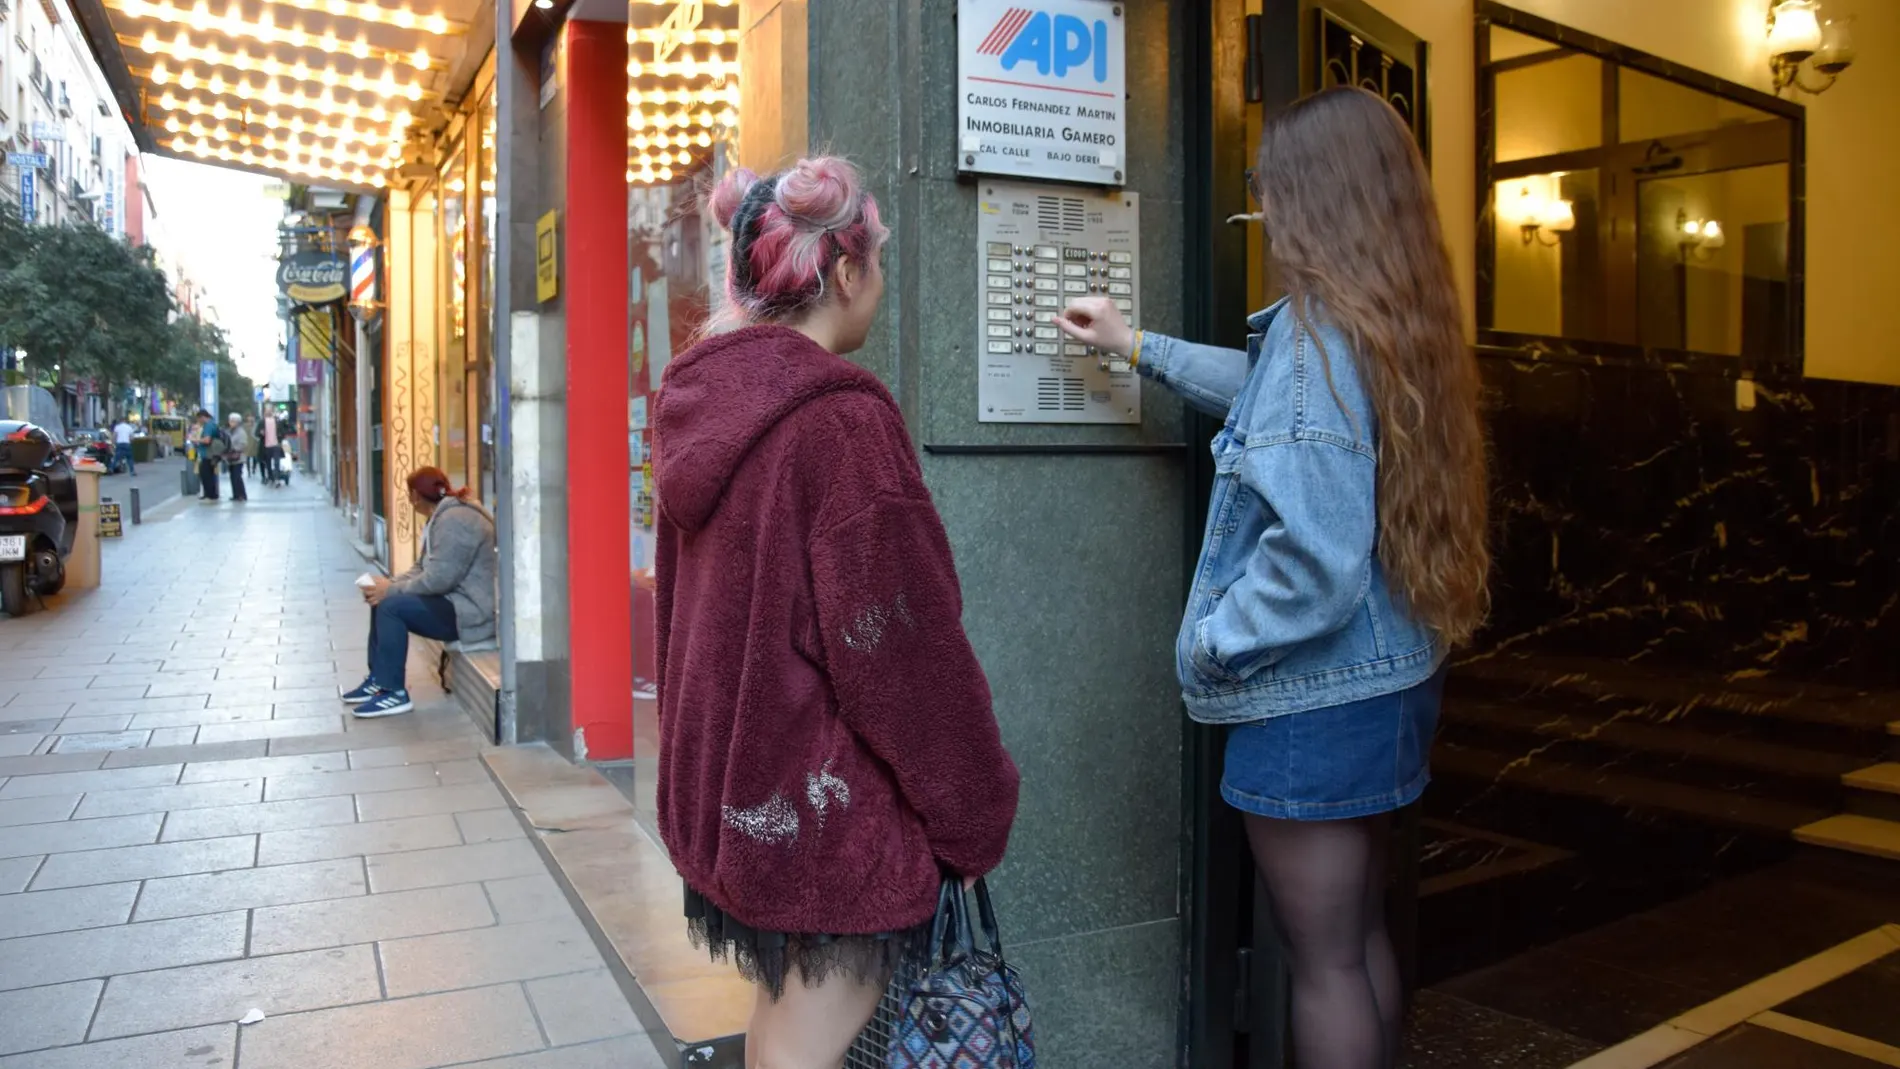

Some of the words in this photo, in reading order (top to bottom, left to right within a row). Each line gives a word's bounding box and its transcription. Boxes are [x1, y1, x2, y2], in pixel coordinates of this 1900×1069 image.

[1000, 11, 1107, 83] API
[967, 93, 1007, 108] CARLOS
[1012, 98, 1071, 116] FERNANDEZ
[1077, 106, 1116, 121] MARTIN
[967, 116, 1055, 140] INMOBILIARIA
[1062, 127, 1116, 146] GAMERO
[1002, 146, 1031, 158] CALLE
[1047, 151, 1072, 162] BAJO
